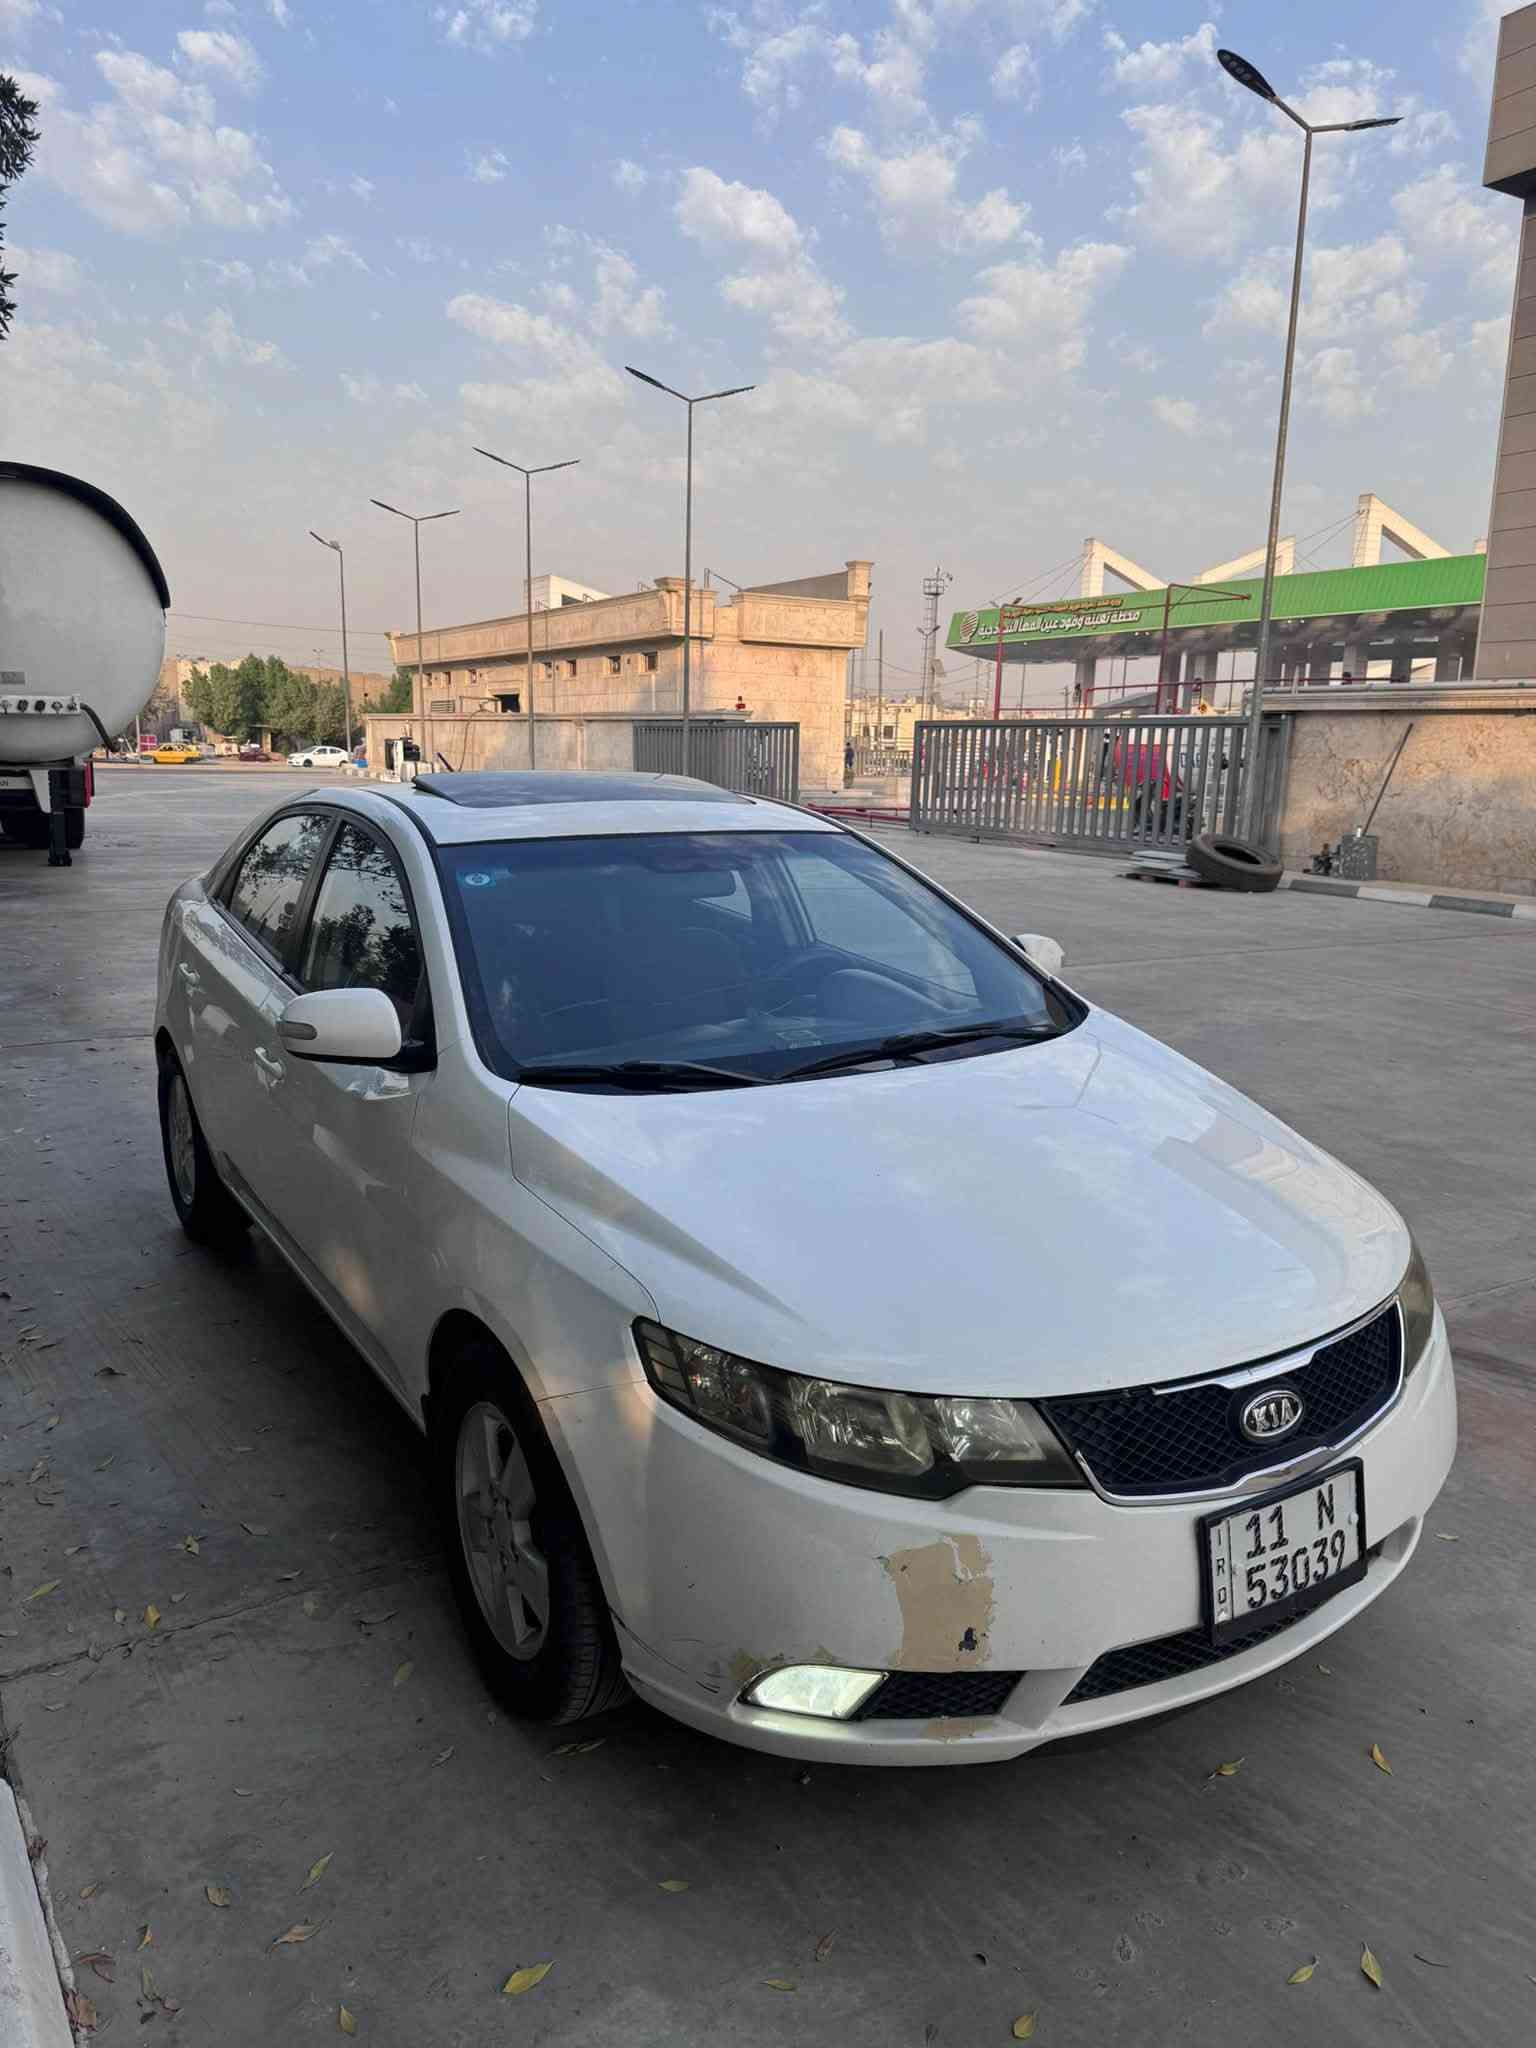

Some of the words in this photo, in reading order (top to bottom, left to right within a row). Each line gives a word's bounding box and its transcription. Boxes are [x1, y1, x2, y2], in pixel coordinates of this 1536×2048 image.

[1060, 615, 1085, 632] وقود
[1110, 609, 1139, 623] محطة
[1253, 1397, 1297, 1433] KIA
[1246, 1504, 1289, 1559] 11
[1317, 1483, 1334, 1530] N
[1246, 1528, 1346, 1609] 53039
